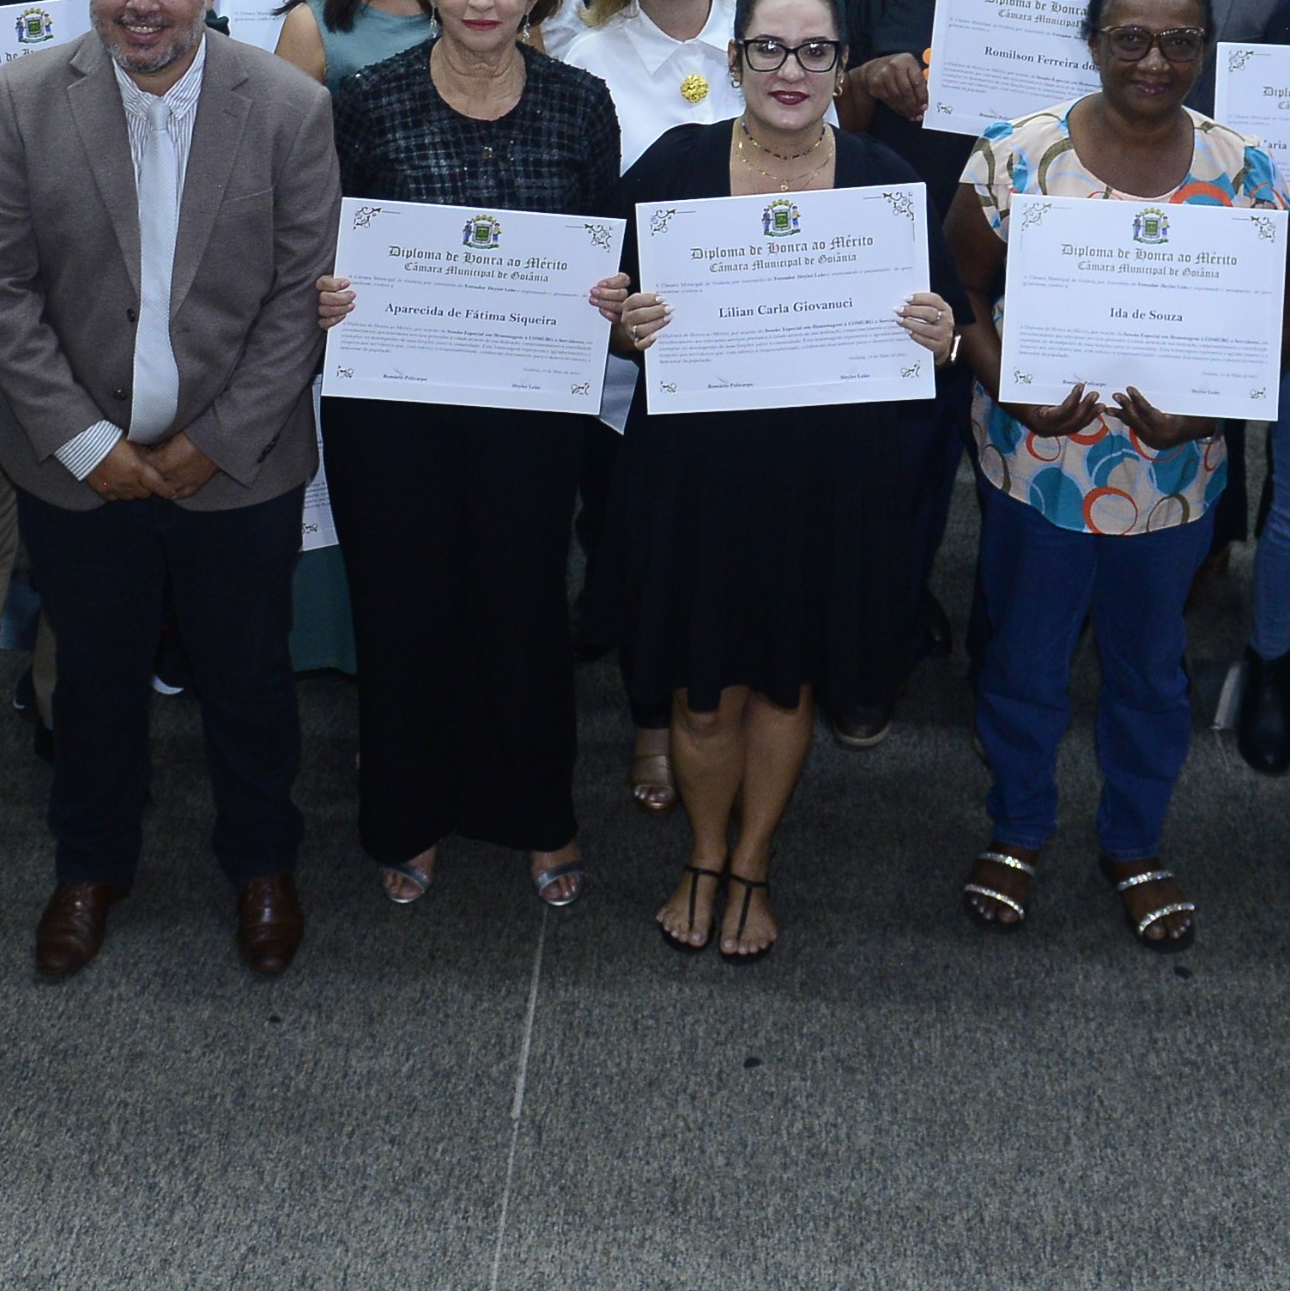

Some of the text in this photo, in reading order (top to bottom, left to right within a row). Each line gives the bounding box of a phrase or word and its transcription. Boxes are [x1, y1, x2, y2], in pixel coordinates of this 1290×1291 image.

[985, 46, 1079, 70] Romilson Ferreira
[388, 245, 567, 270] Diploma de Honra ao Mérito
[691, 235, 873, 260] Diploma de Honra ao Mérito
[1061, 243, 1237, 266] Diploma de Honra ao Mérito
[404, 262, 549, 282] Câmara Municipal de Goiânia
[709, 252, 856, 273] Câmara Municipal de Goiânia
[1078, 260, 1219, 278] Câmara Municipal de Goiânia
[385, 303, 557, 326] Aparecida de Fátima Siqueira
[719, 306, 754, 319] Lilian
[758, 303, 790, 316] Carla
[1110, 307, 1183, 322] Ida de Souza
